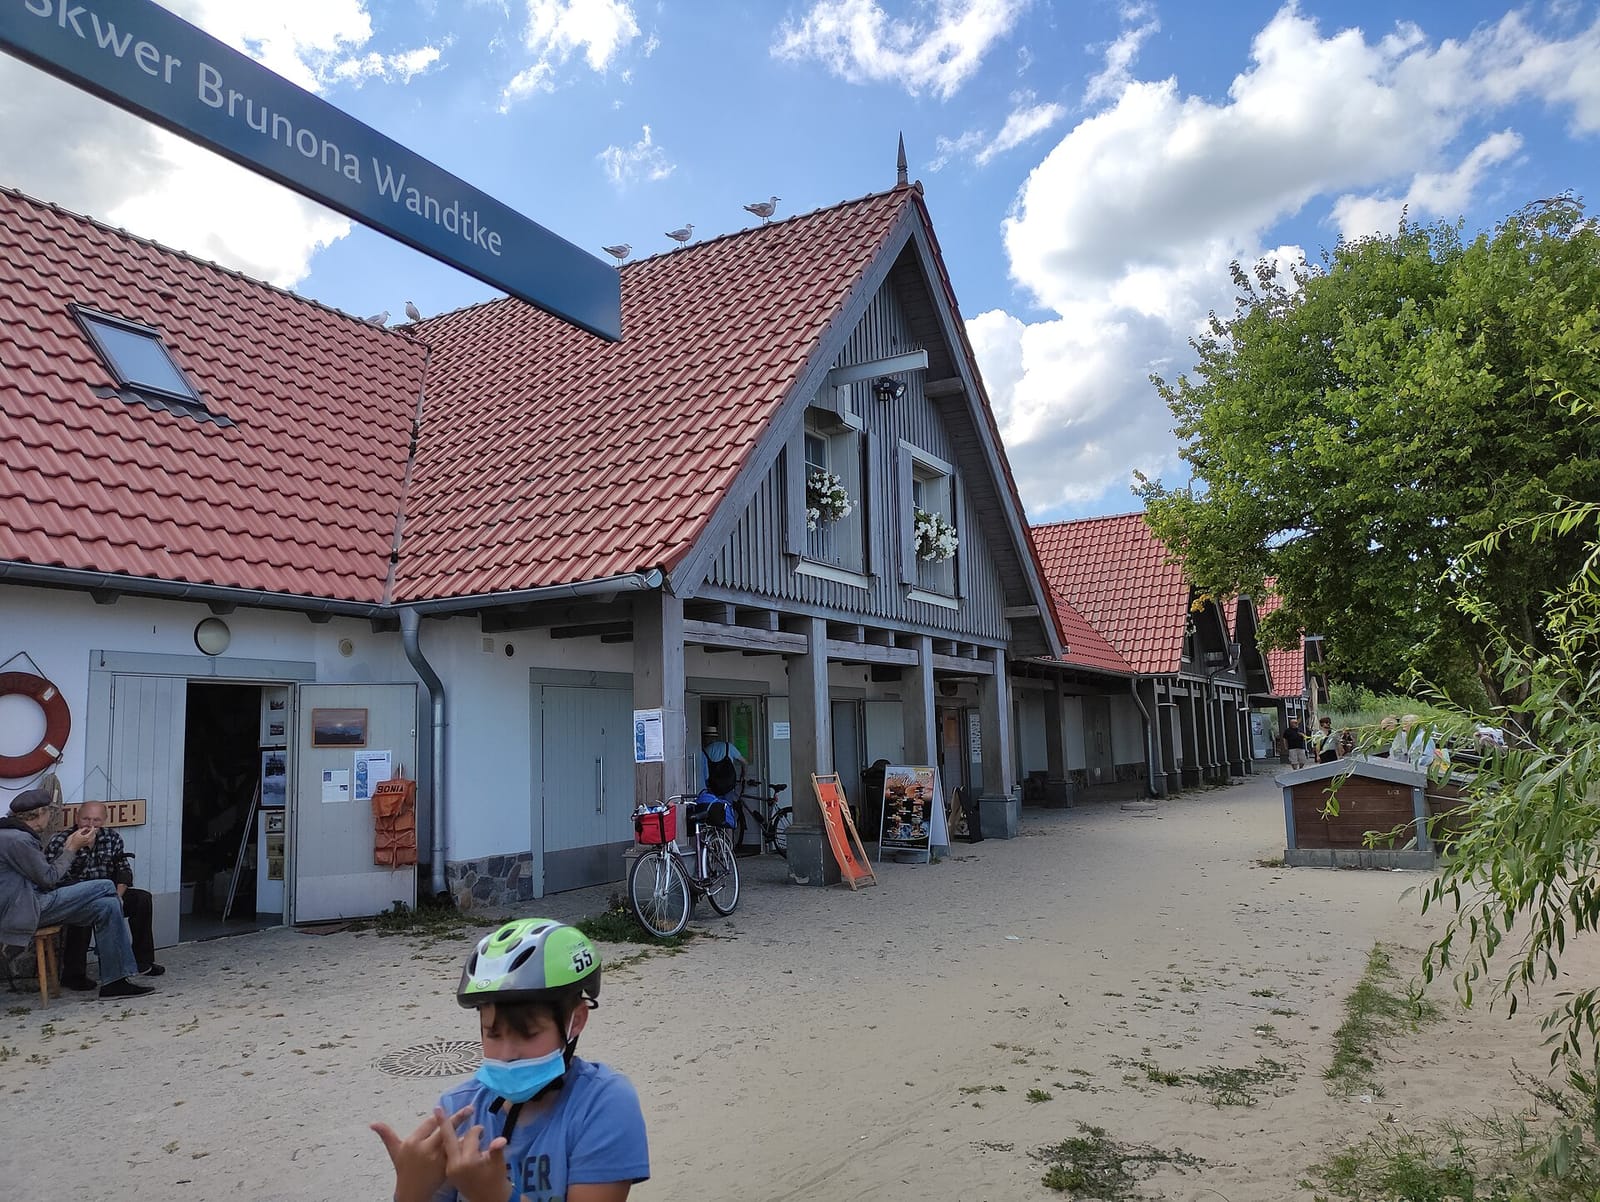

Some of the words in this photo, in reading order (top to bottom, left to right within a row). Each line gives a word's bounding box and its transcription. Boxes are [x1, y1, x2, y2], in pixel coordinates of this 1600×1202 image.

[198, 62, 361, 184] Brunona
[372, 157, 502, 257] Wandtke
[377, 784, 404, 793] SONIA
[572, 949, 593, 974] 55
